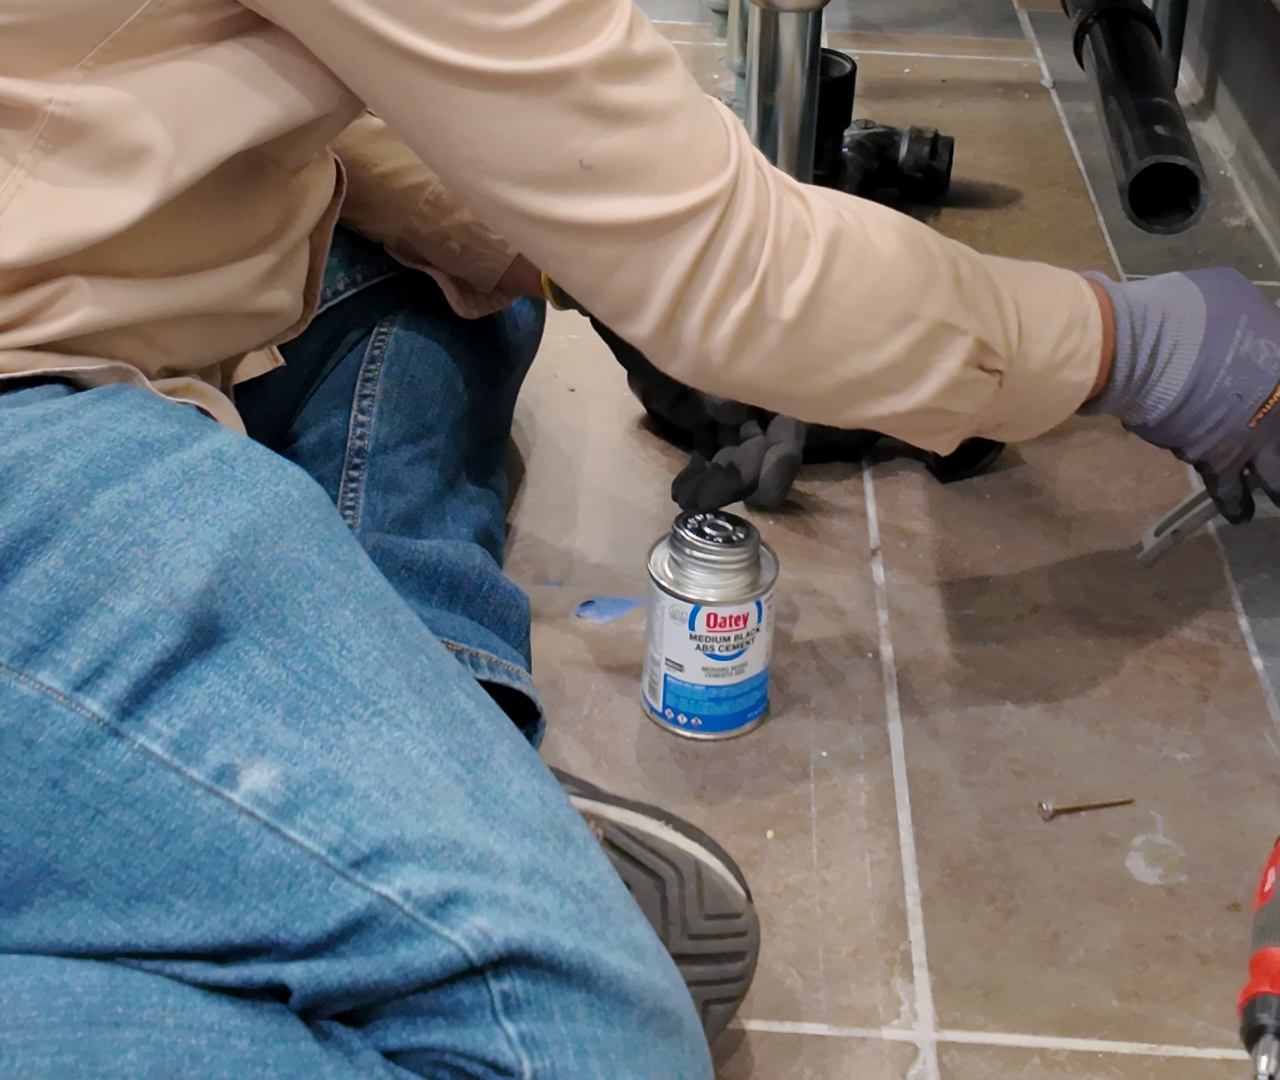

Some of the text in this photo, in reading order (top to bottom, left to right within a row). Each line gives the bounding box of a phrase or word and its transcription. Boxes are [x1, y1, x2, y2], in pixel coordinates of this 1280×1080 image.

[705, 611, 751, 630] Oatey
[689, 626, 761, 644] MEDIUM BLACK
[694, 636, 756, 653] ABS CEMENT
